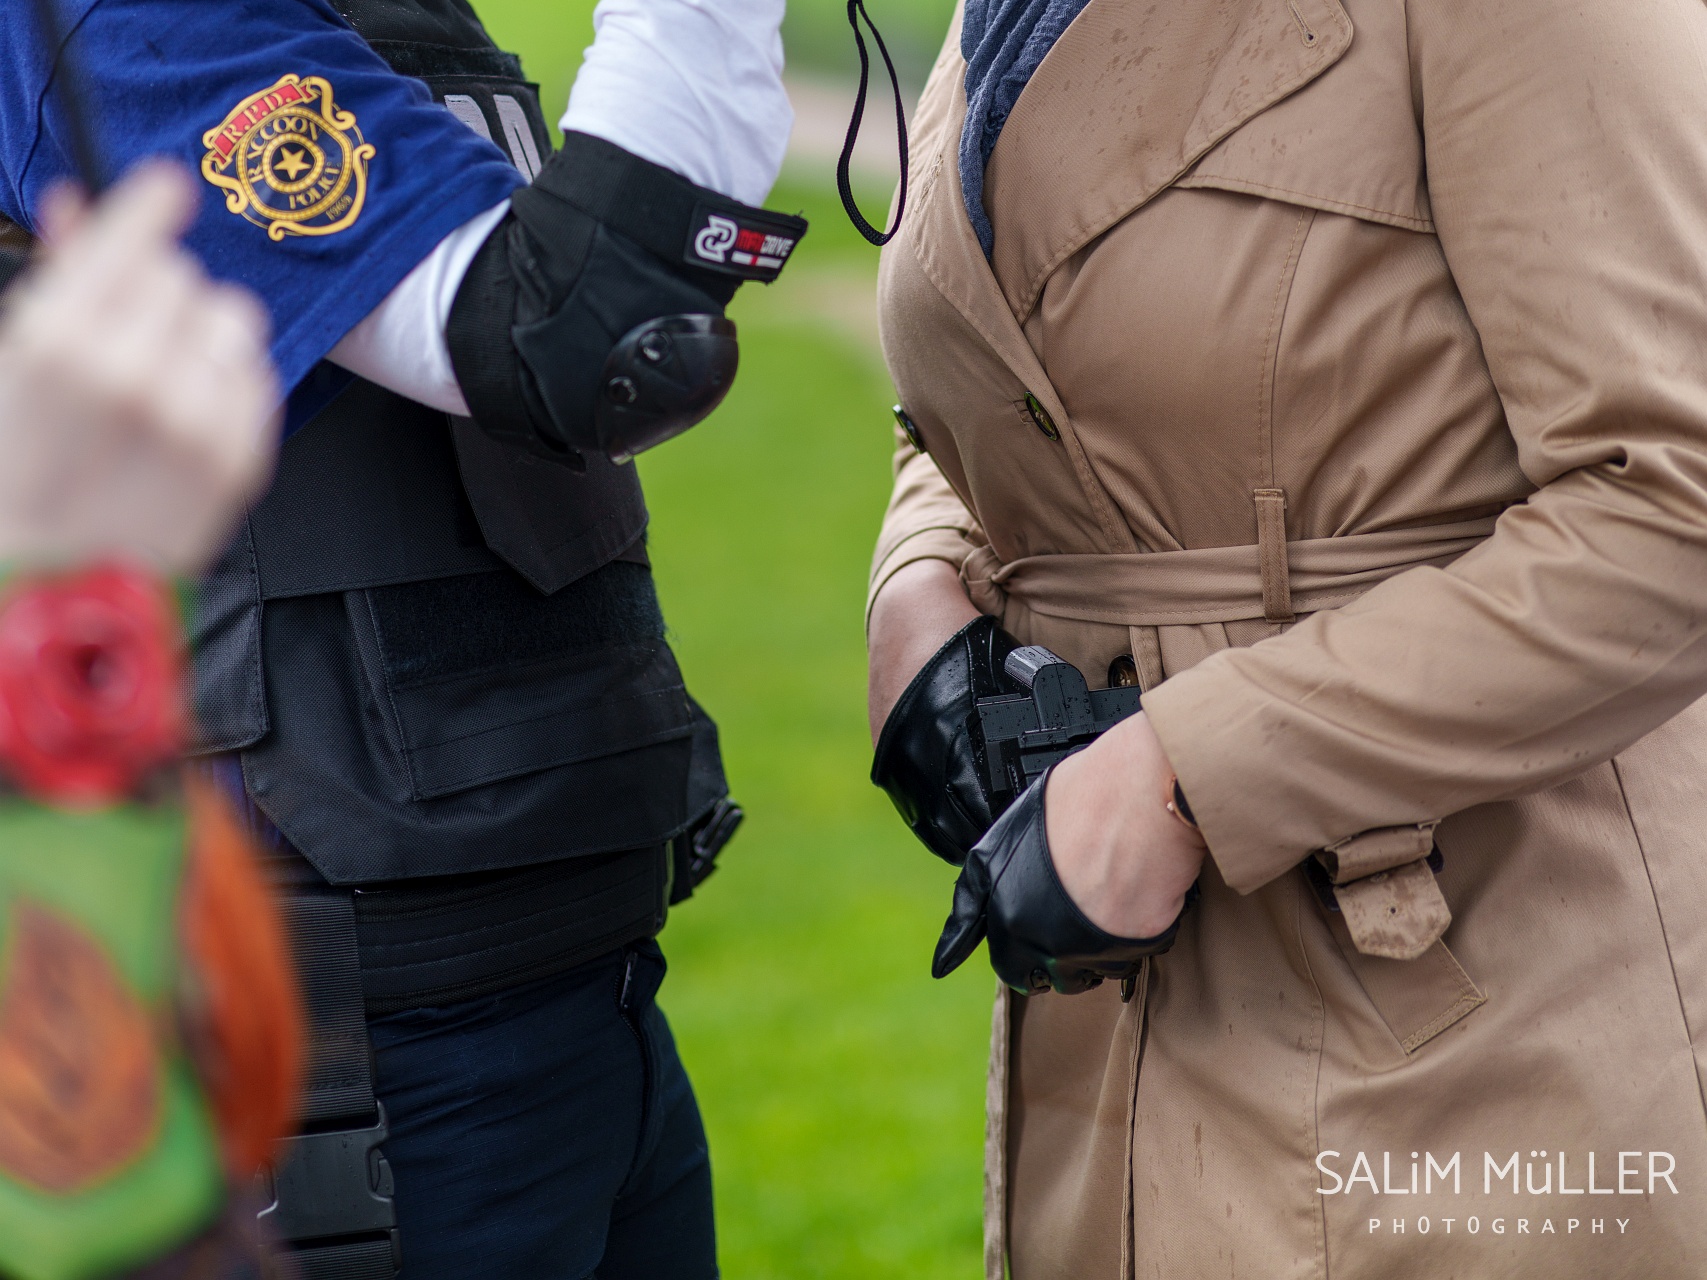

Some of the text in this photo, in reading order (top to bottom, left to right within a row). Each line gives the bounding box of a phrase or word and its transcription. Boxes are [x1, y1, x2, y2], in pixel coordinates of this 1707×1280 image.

[221, 91, 293, 144] R.P.D.
[247, 116, 322, 183] RACCOON
[289, 161, 341, 209] POLICE
